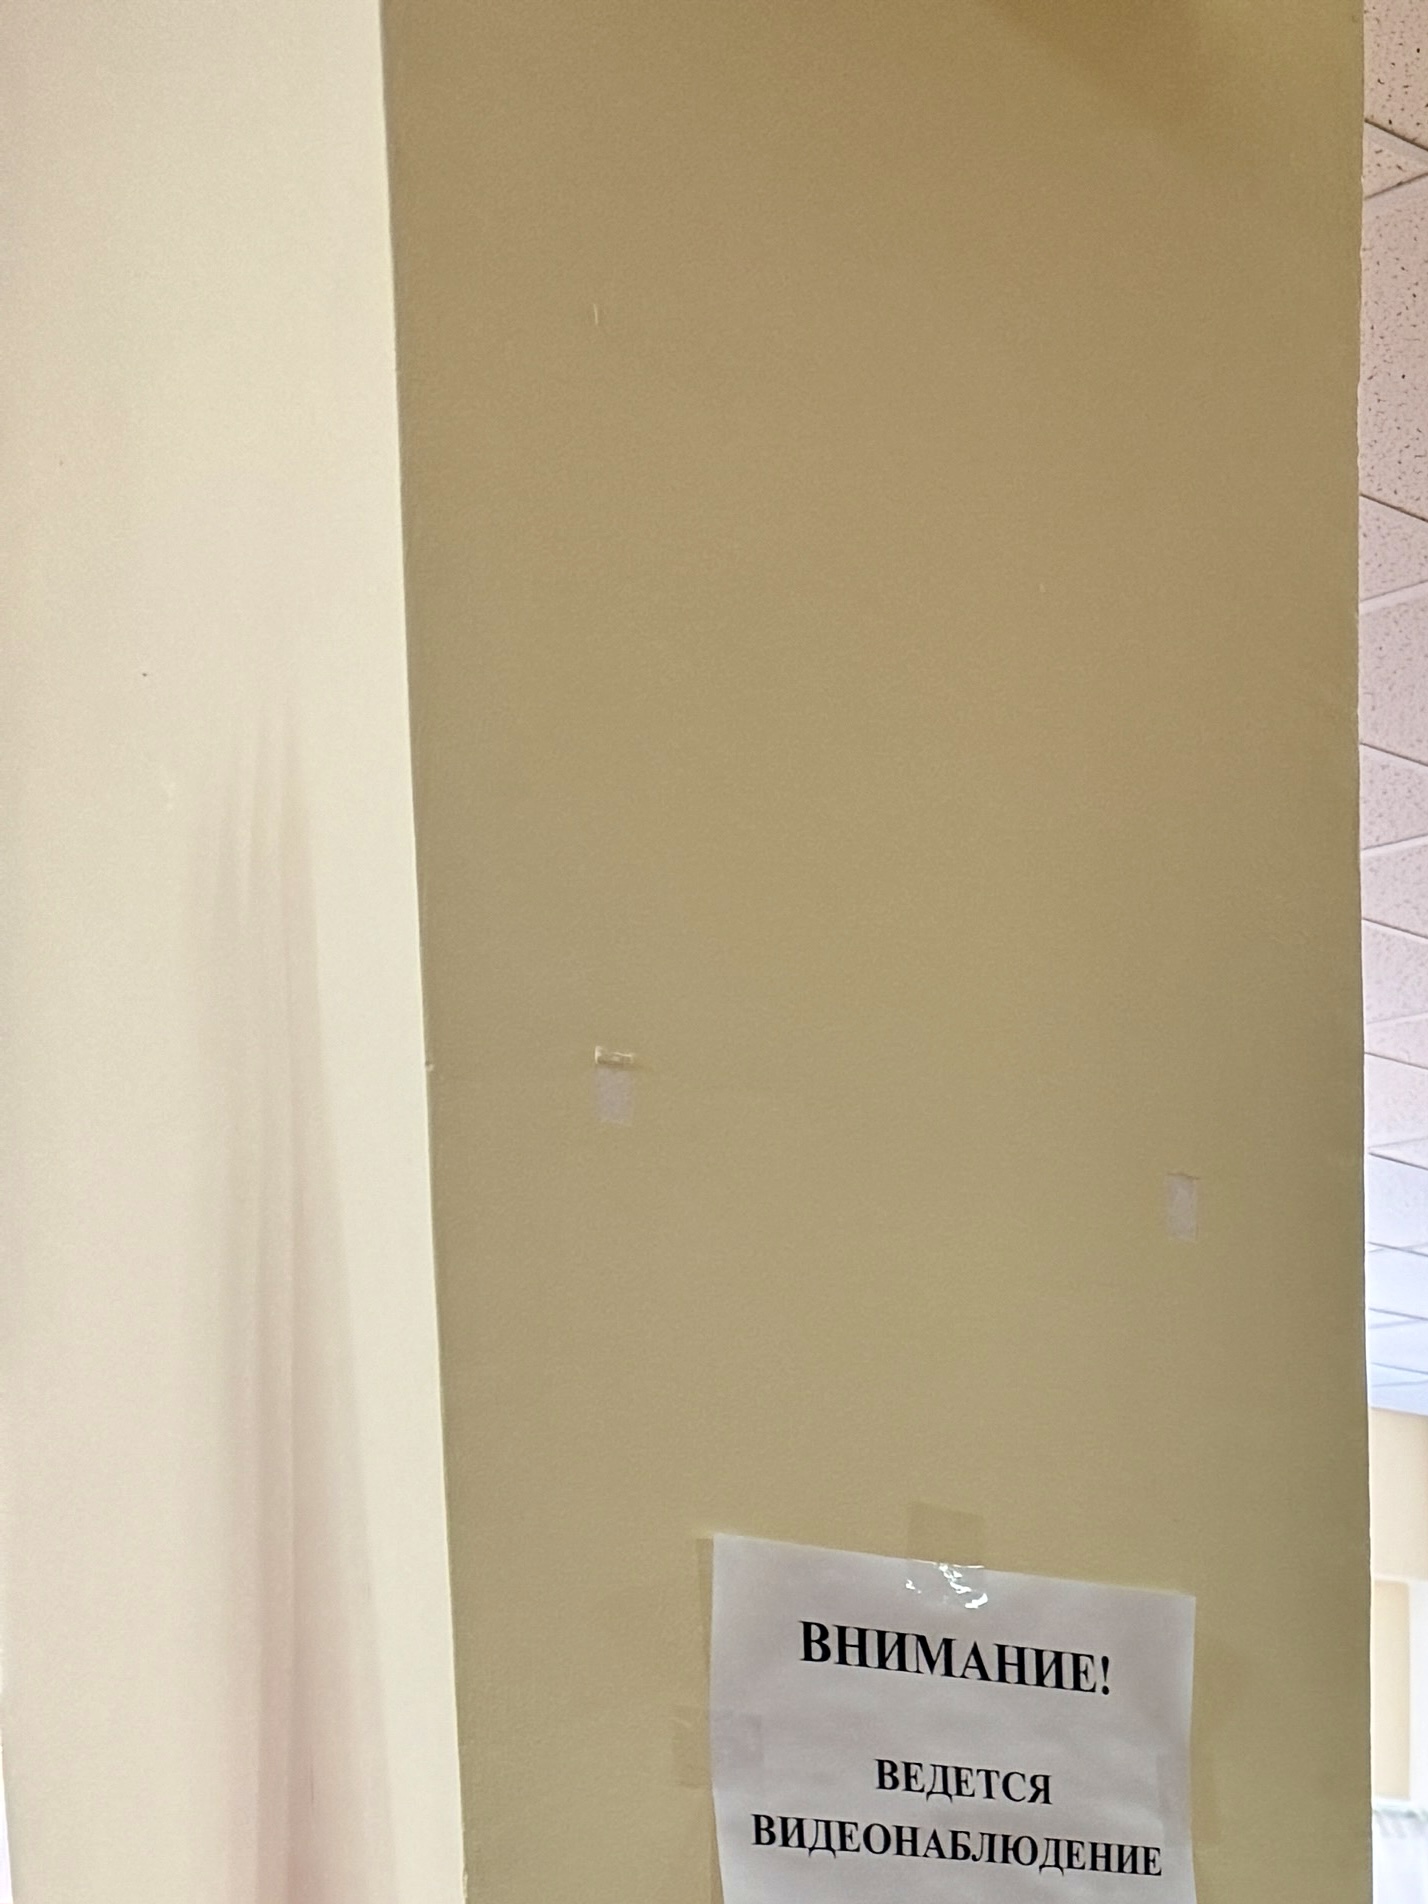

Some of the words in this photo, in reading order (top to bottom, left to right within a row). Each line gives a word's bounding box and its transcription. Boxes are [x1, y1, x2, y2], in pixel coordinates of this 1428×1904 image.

[798, 1620, 1111, 1696] ВНИМАНИЕ!
[875, 1758, 1053, 1805] ВЕДЕТСЯ
[751, 1813, 1163, 1877] ВИДЕОНАБЛЮДЕНИЕ
